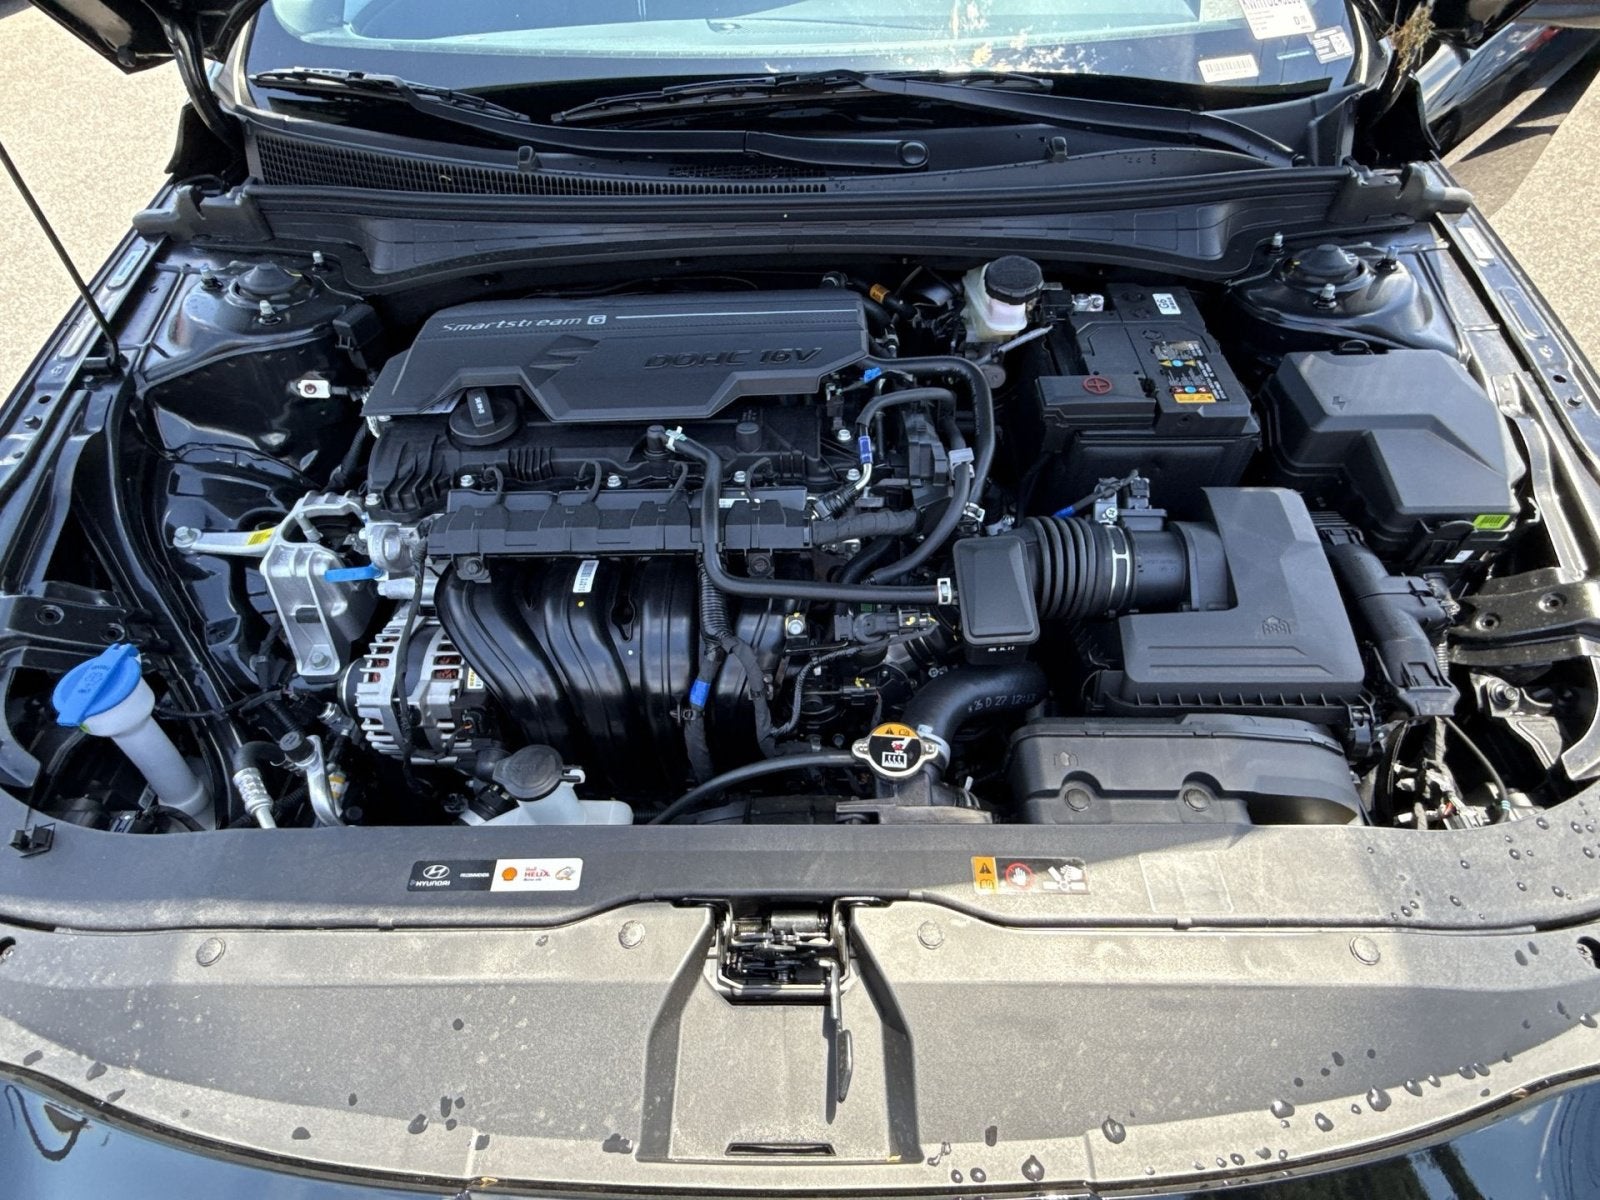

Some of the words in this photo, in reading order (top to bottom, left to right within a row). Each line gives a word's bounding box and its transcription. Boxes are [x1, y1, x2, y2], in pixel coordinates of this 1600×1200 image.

[443, 317, 582, 332] Smartstream
[644, 350, 752, 369] DOHC
[759, 347, 823, 364] 16V
[524, 868, 550, 877] HELIX
[415, 879, 451, 887] HYUNDAI
